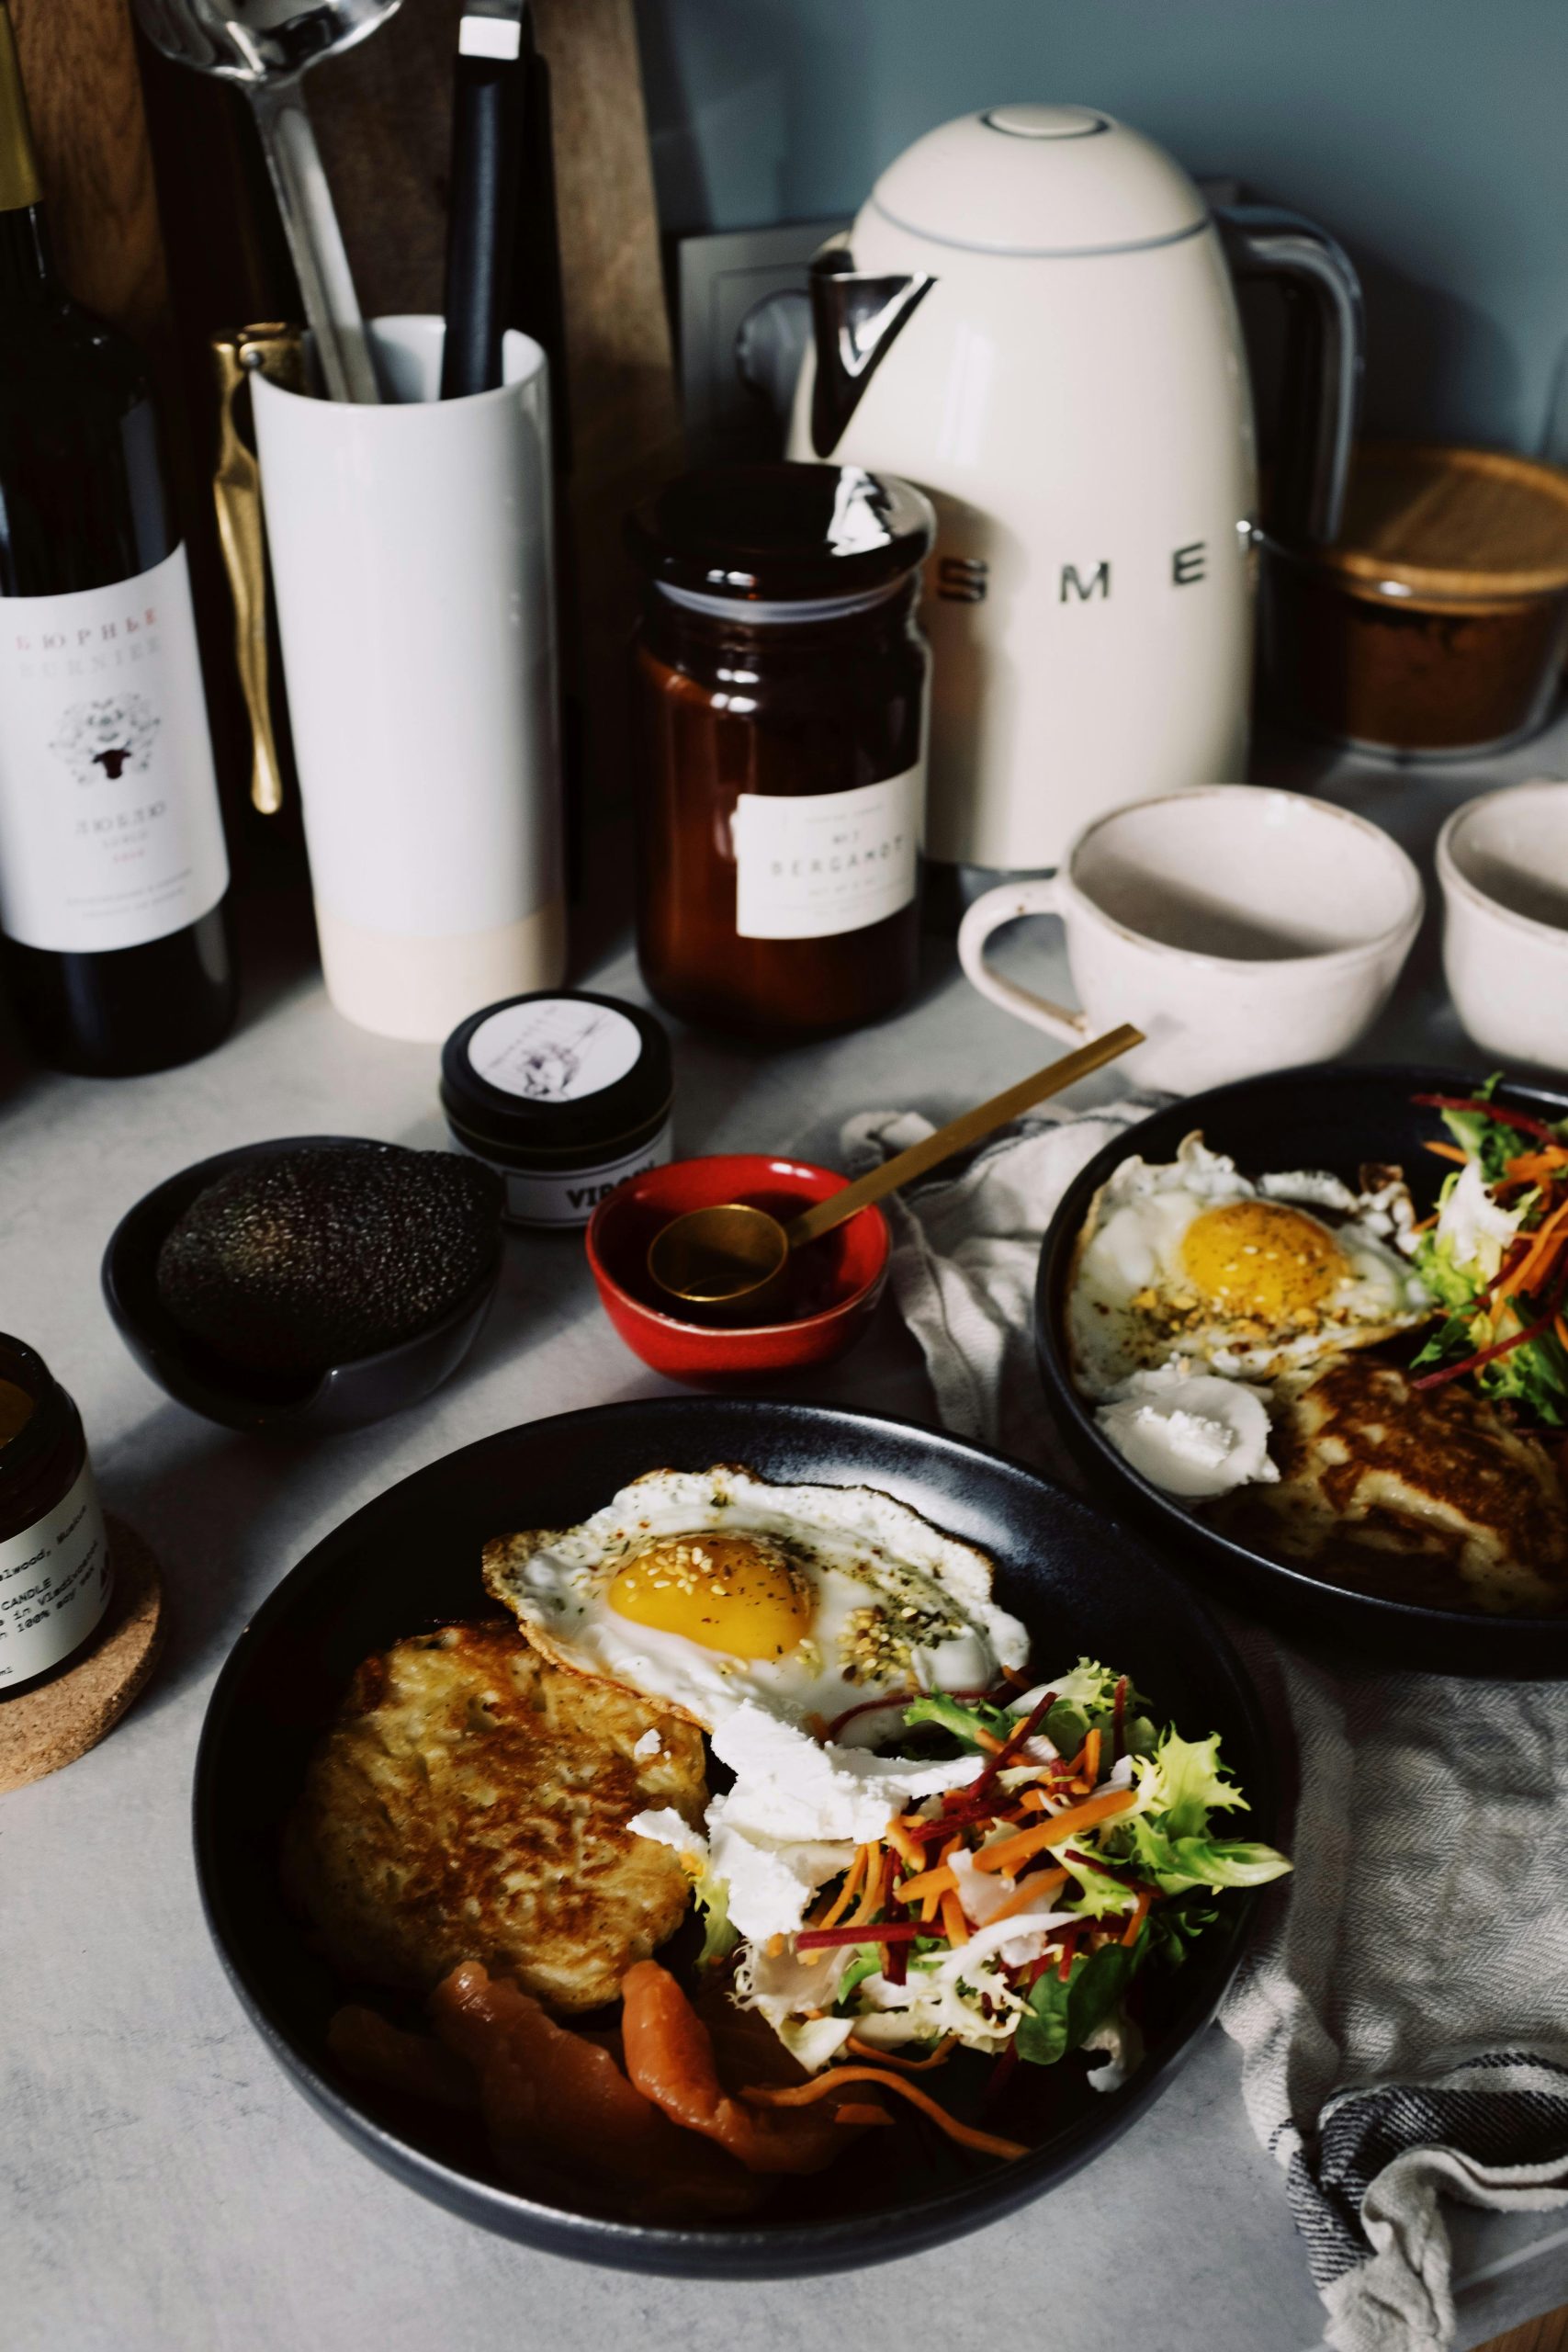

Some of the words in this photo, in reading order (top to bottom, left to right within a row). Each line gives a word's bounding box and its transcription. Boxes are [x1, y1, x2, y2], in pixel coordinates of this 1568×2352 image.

[771, 834, 904, 877] BERGAMOT
[1, 1577, 52, 1611] CANDLE
[13, 1607, 31, 1622] in
[17, 1610, 51, 1633] 100%
